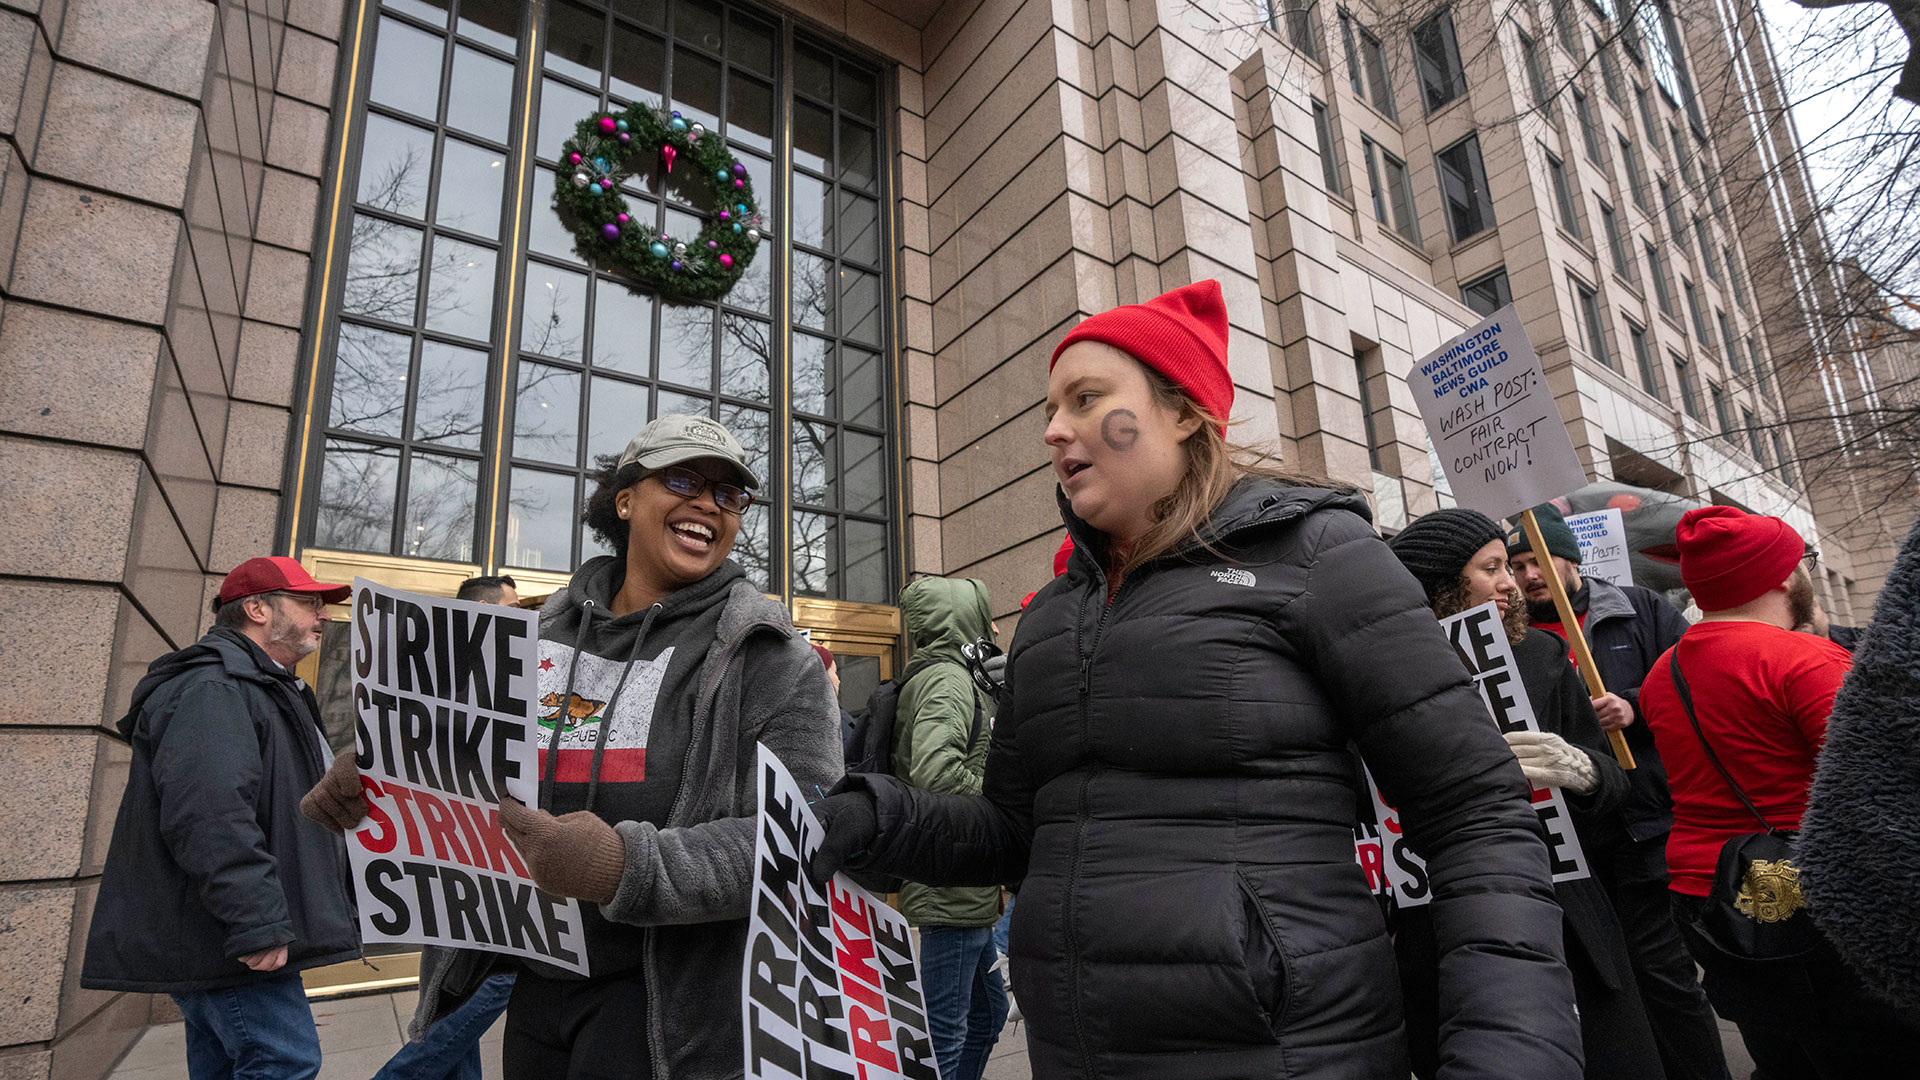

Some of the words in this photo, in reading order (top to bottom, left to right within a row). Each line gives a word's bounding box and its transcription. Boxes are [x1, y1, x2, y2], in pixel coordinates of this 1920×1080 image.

[1421, 323, 1502, 376] WASHINGTON
[1431, 339, 1500, 385] BALTIMORE
[1434, 373, 1466, 399] NEWS
[1468, 351, 1508, 379] GUILD
[1459, 377, 1489, 398] CWA
[1440, 396, 1485, 432] WASH
[1494, 368, 1537, 407] POST:
[1101, 408, 1138, 451] G
[1454, 416, 1547, 474] CONTRACT
[1470, 417, 1505, 445] FAIR
[1567, 514, 1608, 527] HINGTON
[1571, 522, 1605, 534] TIMORE
[1578, 540, 1592, 548] WA
[1581, 529, 1608, 540] GUILD
[1210, 570, 1242, 580] NORTH
[1216, 576, 1239, 584] FACE
[1227, 567, 1245, 575] THE
[355, 587, 527, 718] STRIKE
[354, 683, 527, 808] STRIKE
[356, 776, 532, 880] STRIK
[365, 860, 579, 966] STRIKE
[749, 762, 803, 1080] TRIKE
[827, 877, 900, 1080] RIKE
[867, 903, 941, 1080] RIKE
